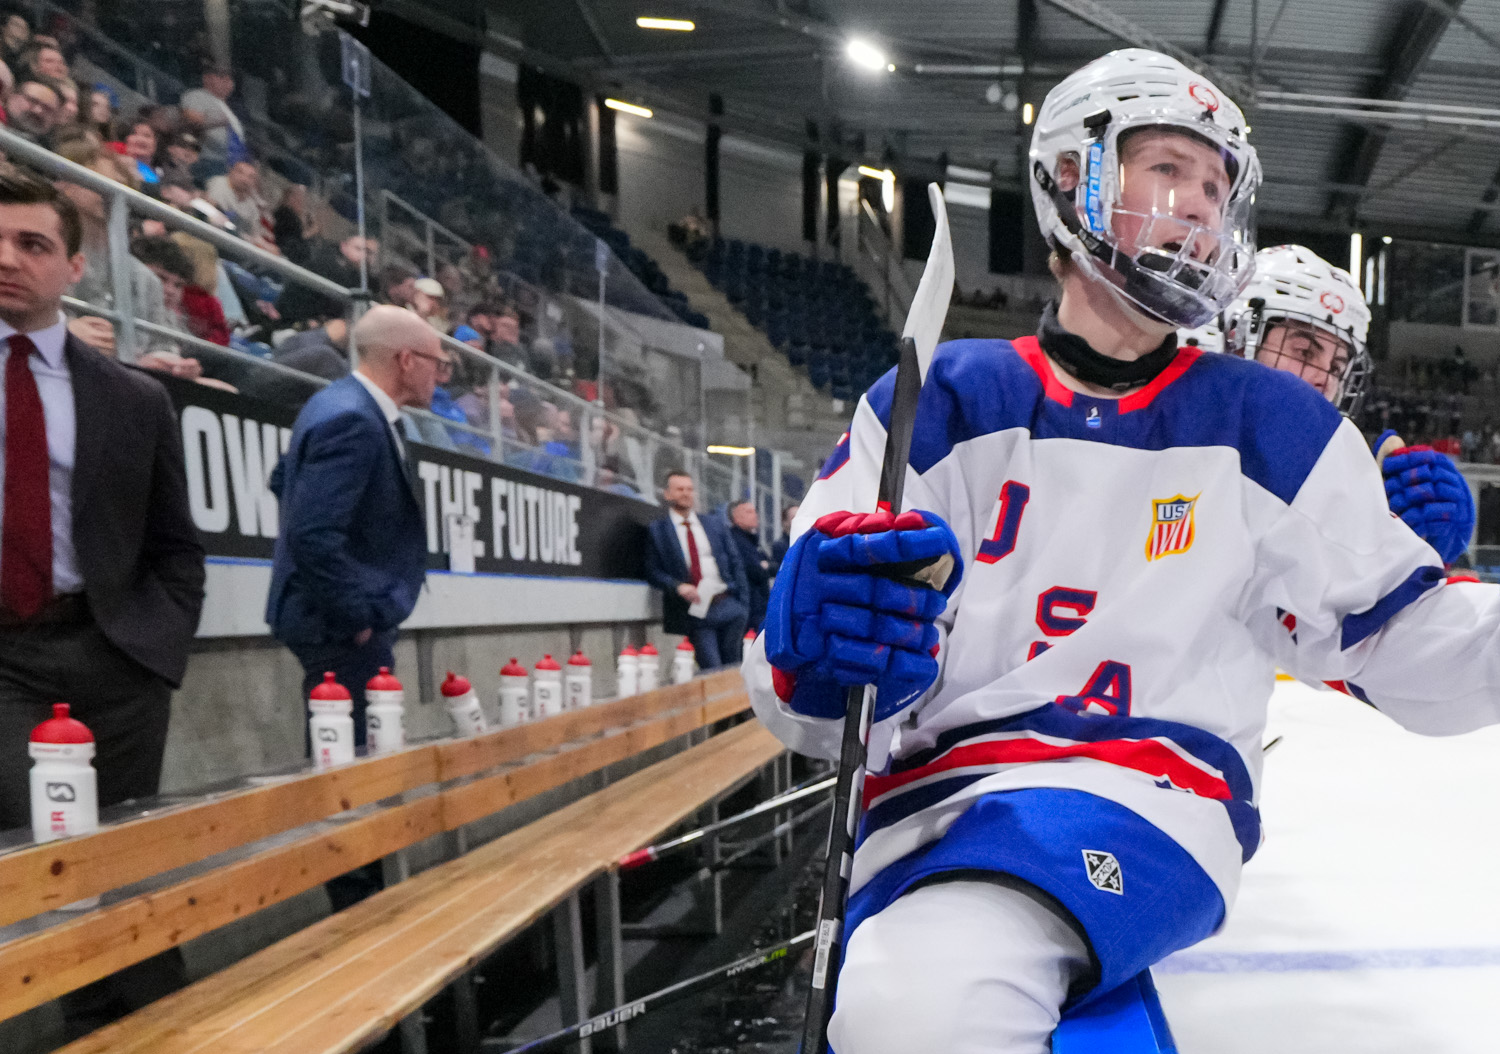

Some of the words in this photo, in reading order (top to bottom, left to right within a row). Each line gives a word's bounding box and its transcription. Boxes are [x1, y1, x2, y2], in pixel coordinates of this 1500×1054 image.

[181, 404, 294, 539] OW
[418, 460, 486, 557] THE
[491, 476, 583, 567] FUTURE
